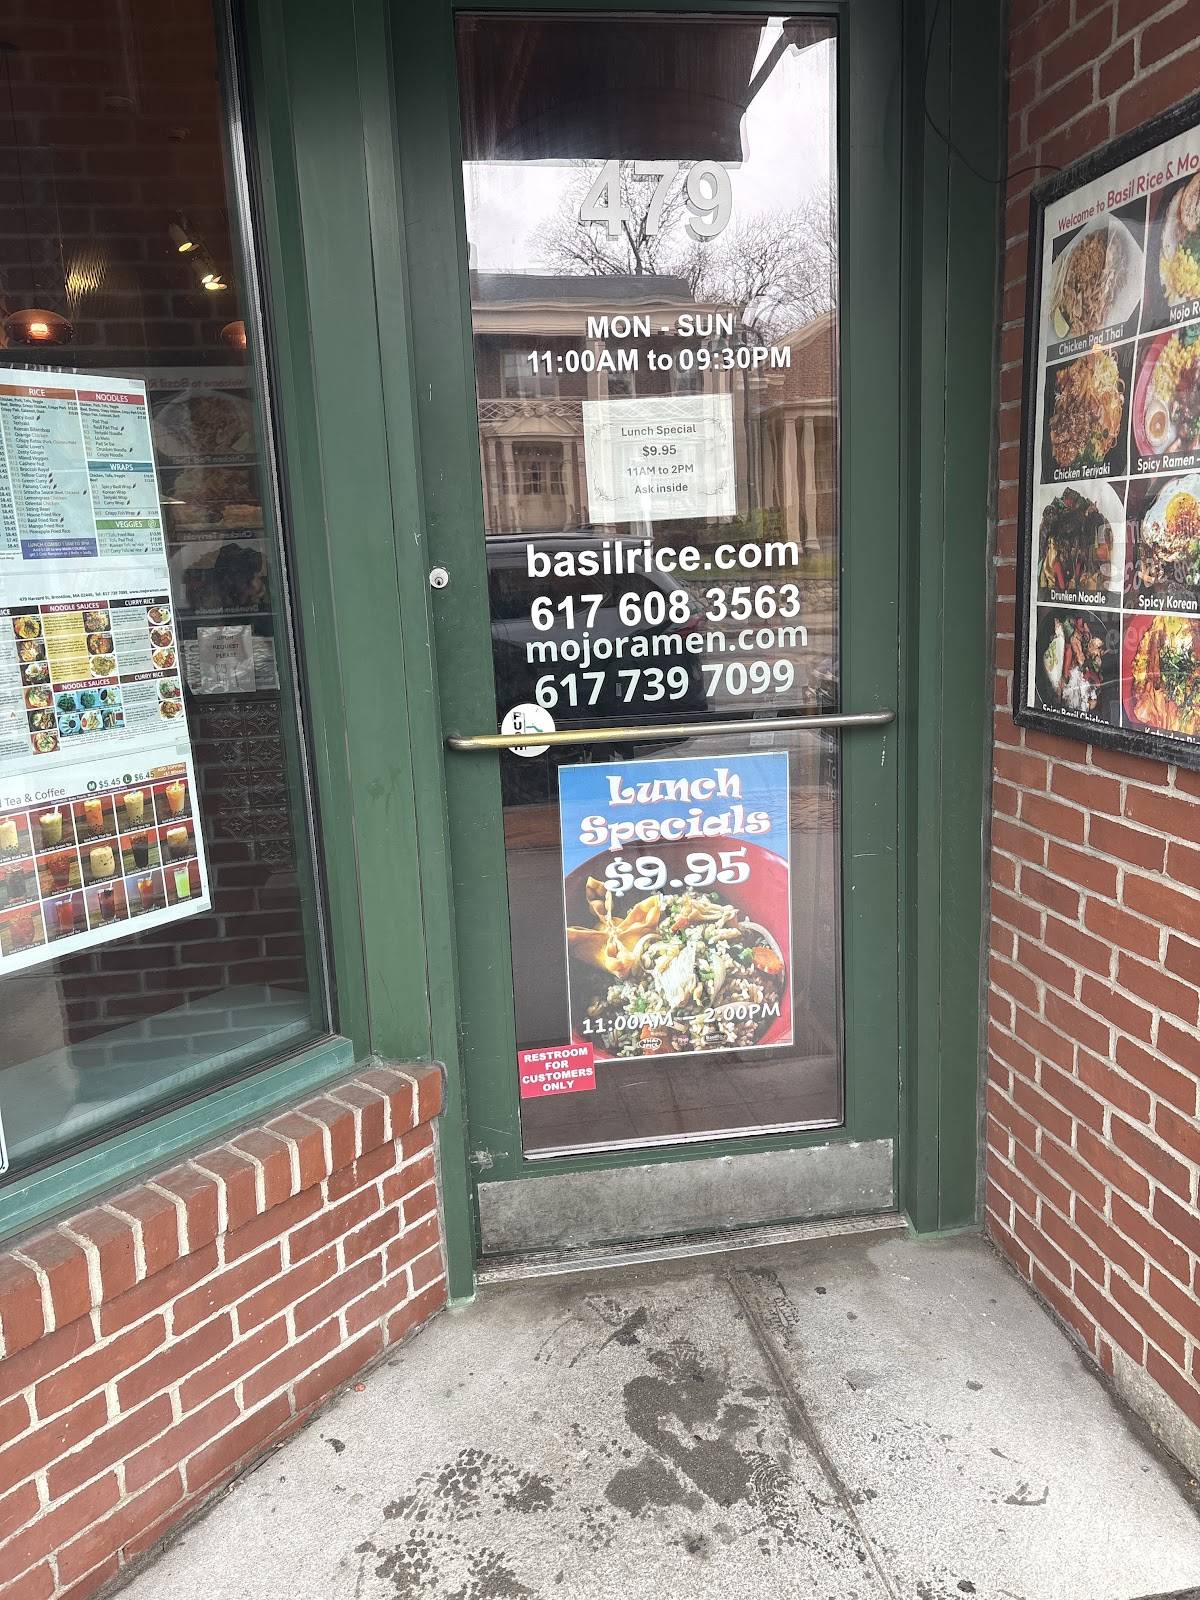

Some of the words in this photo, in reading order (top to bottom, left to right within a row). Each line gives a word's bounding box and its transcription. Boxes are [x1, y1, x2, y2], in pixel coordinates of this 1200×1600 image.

[1058, 206, 1095, 231] Welcome
[1096, 200, 1105, 214] to
[1107, 181, 1135, 209] Basil
[1136, 172, 1163, 194] Rice
[1165, 161, 1174, 181] &
[1177, 152, 1200, 176] Mo
[580, 160, 732, 240] 479
[1170, 305, 1190, 323] Mojo
[1193, 301, 1200, 316] R
[587, 316, 650, 339] MON
[677, 313, 734, 337] SUN
[1059, 340, 1087, 356] Chicken
[1088, 332, 1104, 348] Pad
[1105, 325, 1123, 341] Thai
[527, 349, 639, 373] 11:00AM
[647, 351, 672, 371] to
[680, 346, 791, 370] 09:30PM
[28, 388, 46, 397] RICE
[95, 393, 129, 403] NOODLES
[620, 425, 654, 437] Lunch
[656, 423, 697, 437] Special
[642, 445, 677, 457] $9.95
[110, 463, 134, 471] WRAPS
[626, 465, 656, 477] 11AM
[658, 465, 669, 475] to
[671, 463, 694, 475] 2PM
[1053, 467, 1081, 480] Chicken
[1081, 462, 1110, 479] Teriyaki
[1137, 457, 1161, 472] Spicy
[1162, 456, 1194, 469] Ramen
[634, 483, 655, 495] Ask
[656, 482, 688, 493] inside
[115, 520, 143, 528] VEGGIES
[526, 539, 799, 579] basilrice.com
[144, 597, 155, 605] RICE
[1051, 589, 1077, 602] Drunken
[1078, 591, 1106, 604] Noodle
[1138, 594, 1164, 610] Spicy
[1166, 596, 1198, 610] Korean
[0, 608, 11, 616] ICE
[49, 604, 76, 612] NOODLE
[530, 594, 604, 631] 617
[618, 589, 690, 627] 608
[705, 584, 801, 622] 3563
[526, 624, 808, 668] mojoramen.com
[62, 681, 88, 690] NOODLE
[88, 679, 110, 687] SAUCES
[134, 673, 152, 681] CURRY
[535, 672, 606, 709] 617
[618, 666, 689, 703] 739
[701, 659, 795, 698] 7099
[4, 797, 22, 806] Tea
[24, 793, 33, 802] &
[35, 787, 66, 801] Coffee
[98, 777, 121, 788] $5.45
[134, 771, 155, 781] $6.45
[606, 768, 743, 806] Lunch
[579, 805, 772, 851] Specials
[604, 847, 751, 896] $9.95
[582, 1011, 675, 1034] 11:00AM
[704, 1002, 781, 1024] 2:00PM
[523, 1047, 588, 1063] RESTROOM
[545, 1060, 569, 1070] FOR
[522, 1068, 593, 1084] CUSTOMERS
[542, 1080, 575, 1092] ONLY
